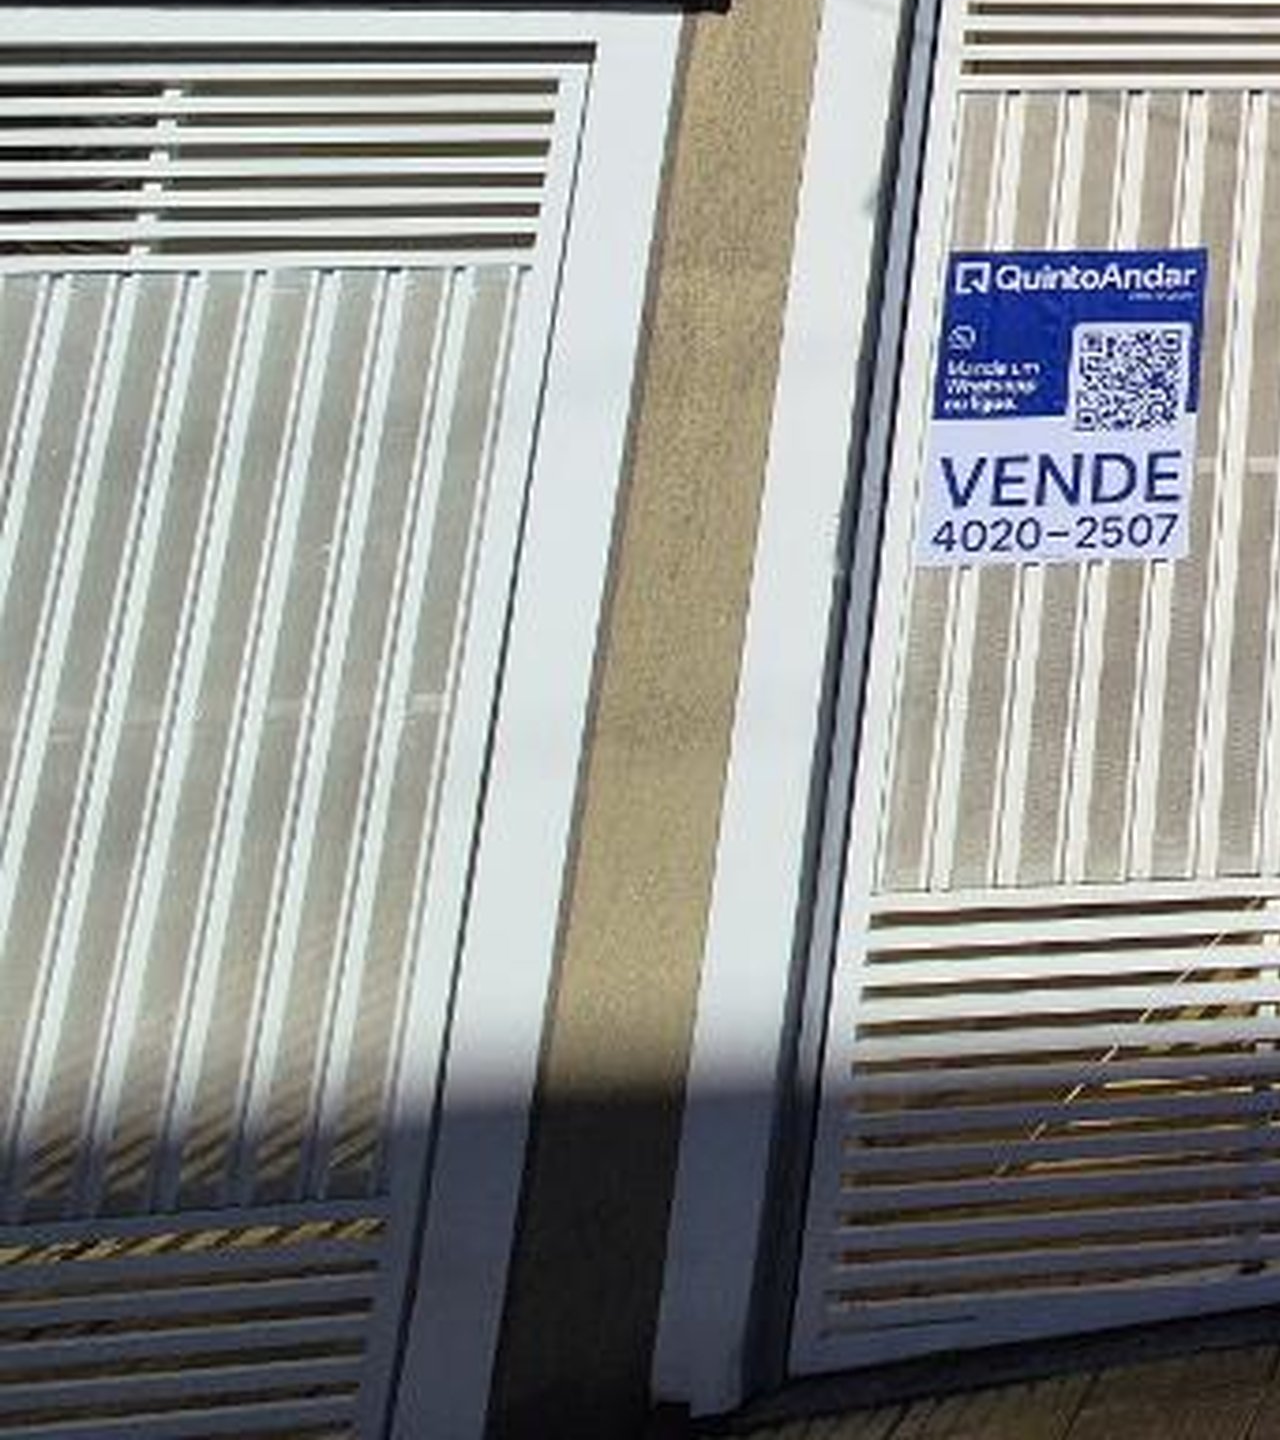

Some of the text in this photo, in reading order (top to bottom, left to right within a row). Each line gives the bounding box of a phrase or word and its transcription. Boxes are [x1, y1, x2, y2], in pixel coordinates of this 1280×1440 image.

[996, 263, 1197, 292] QuintoAndar
[940, 451, 1182, 508] VENDE
[932, 514, 1179, 552] 4020-2507
